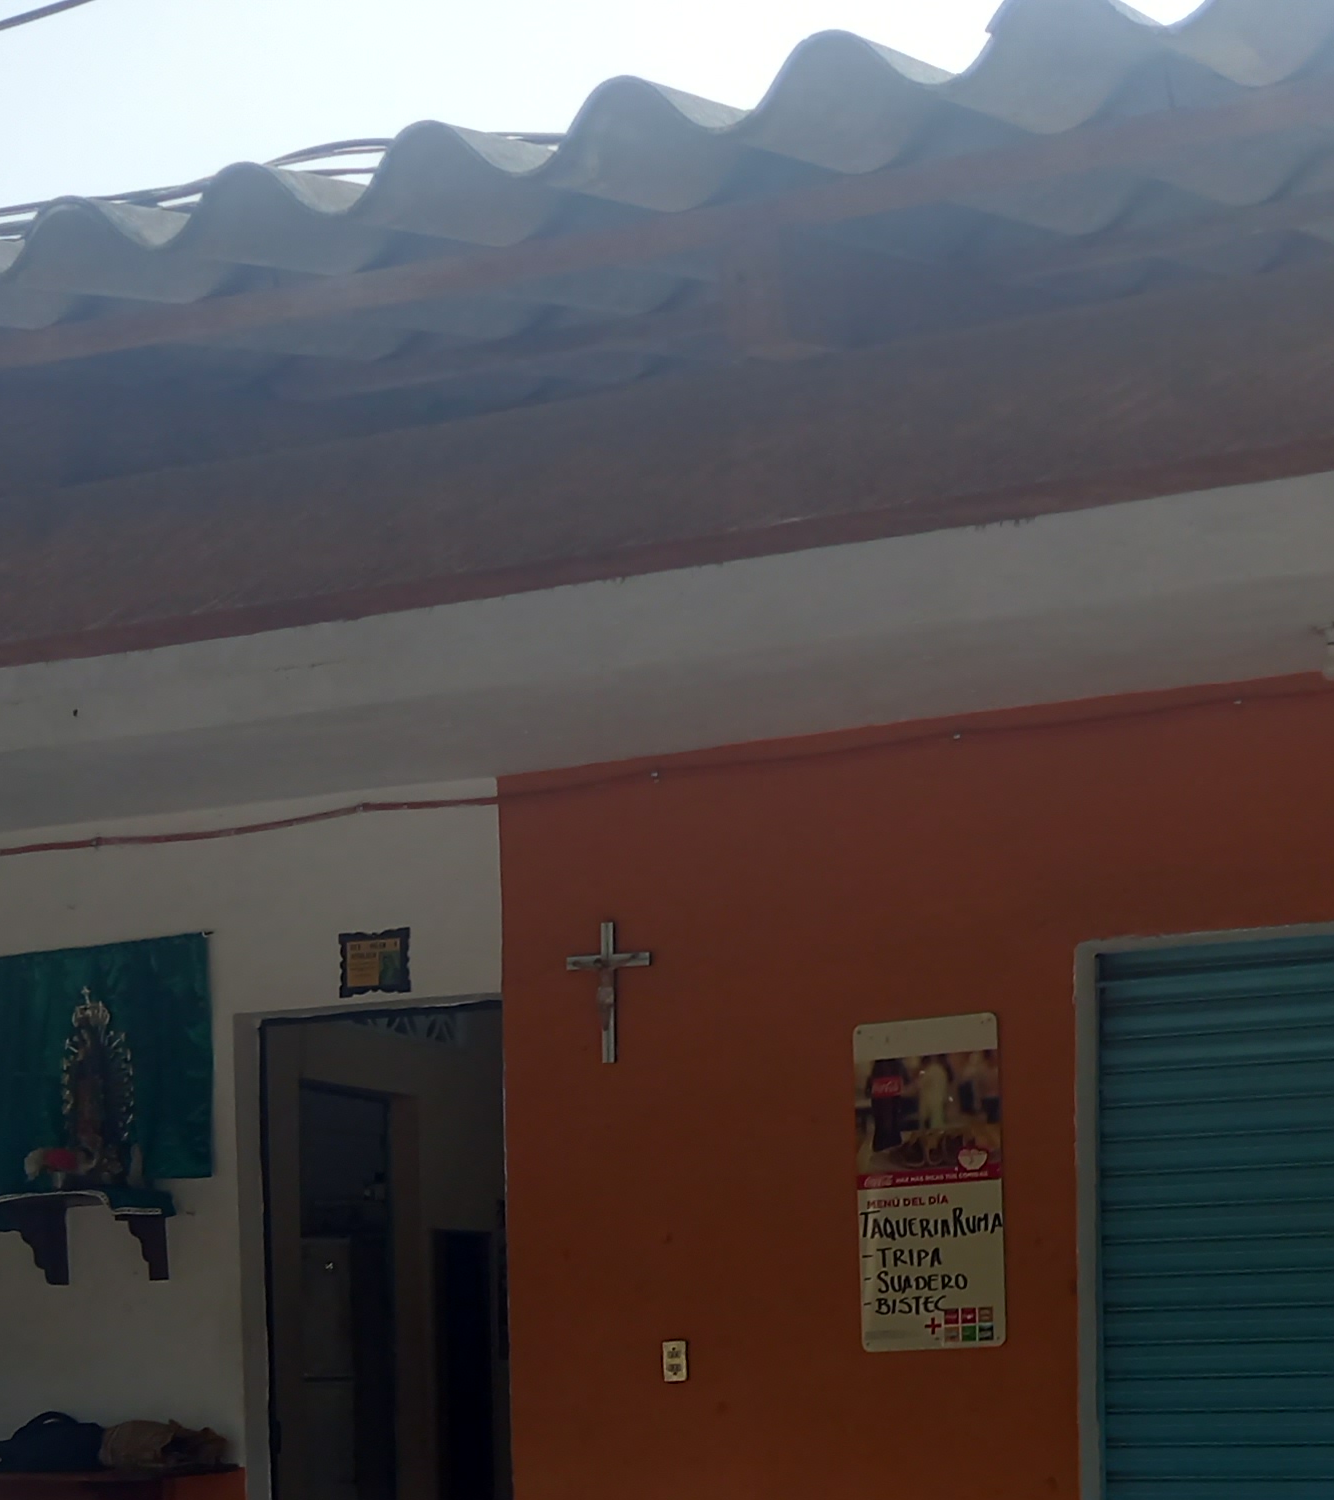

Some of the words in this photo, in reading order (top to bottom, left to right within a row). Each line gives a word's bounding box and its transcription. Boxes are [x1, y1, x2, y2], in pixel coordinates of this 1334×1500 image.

[867, 1194, 900, 1209] MENÚ
[903, 1196, 925, 1207] DEL
[928, 1193, 949, 1205] DÍA
